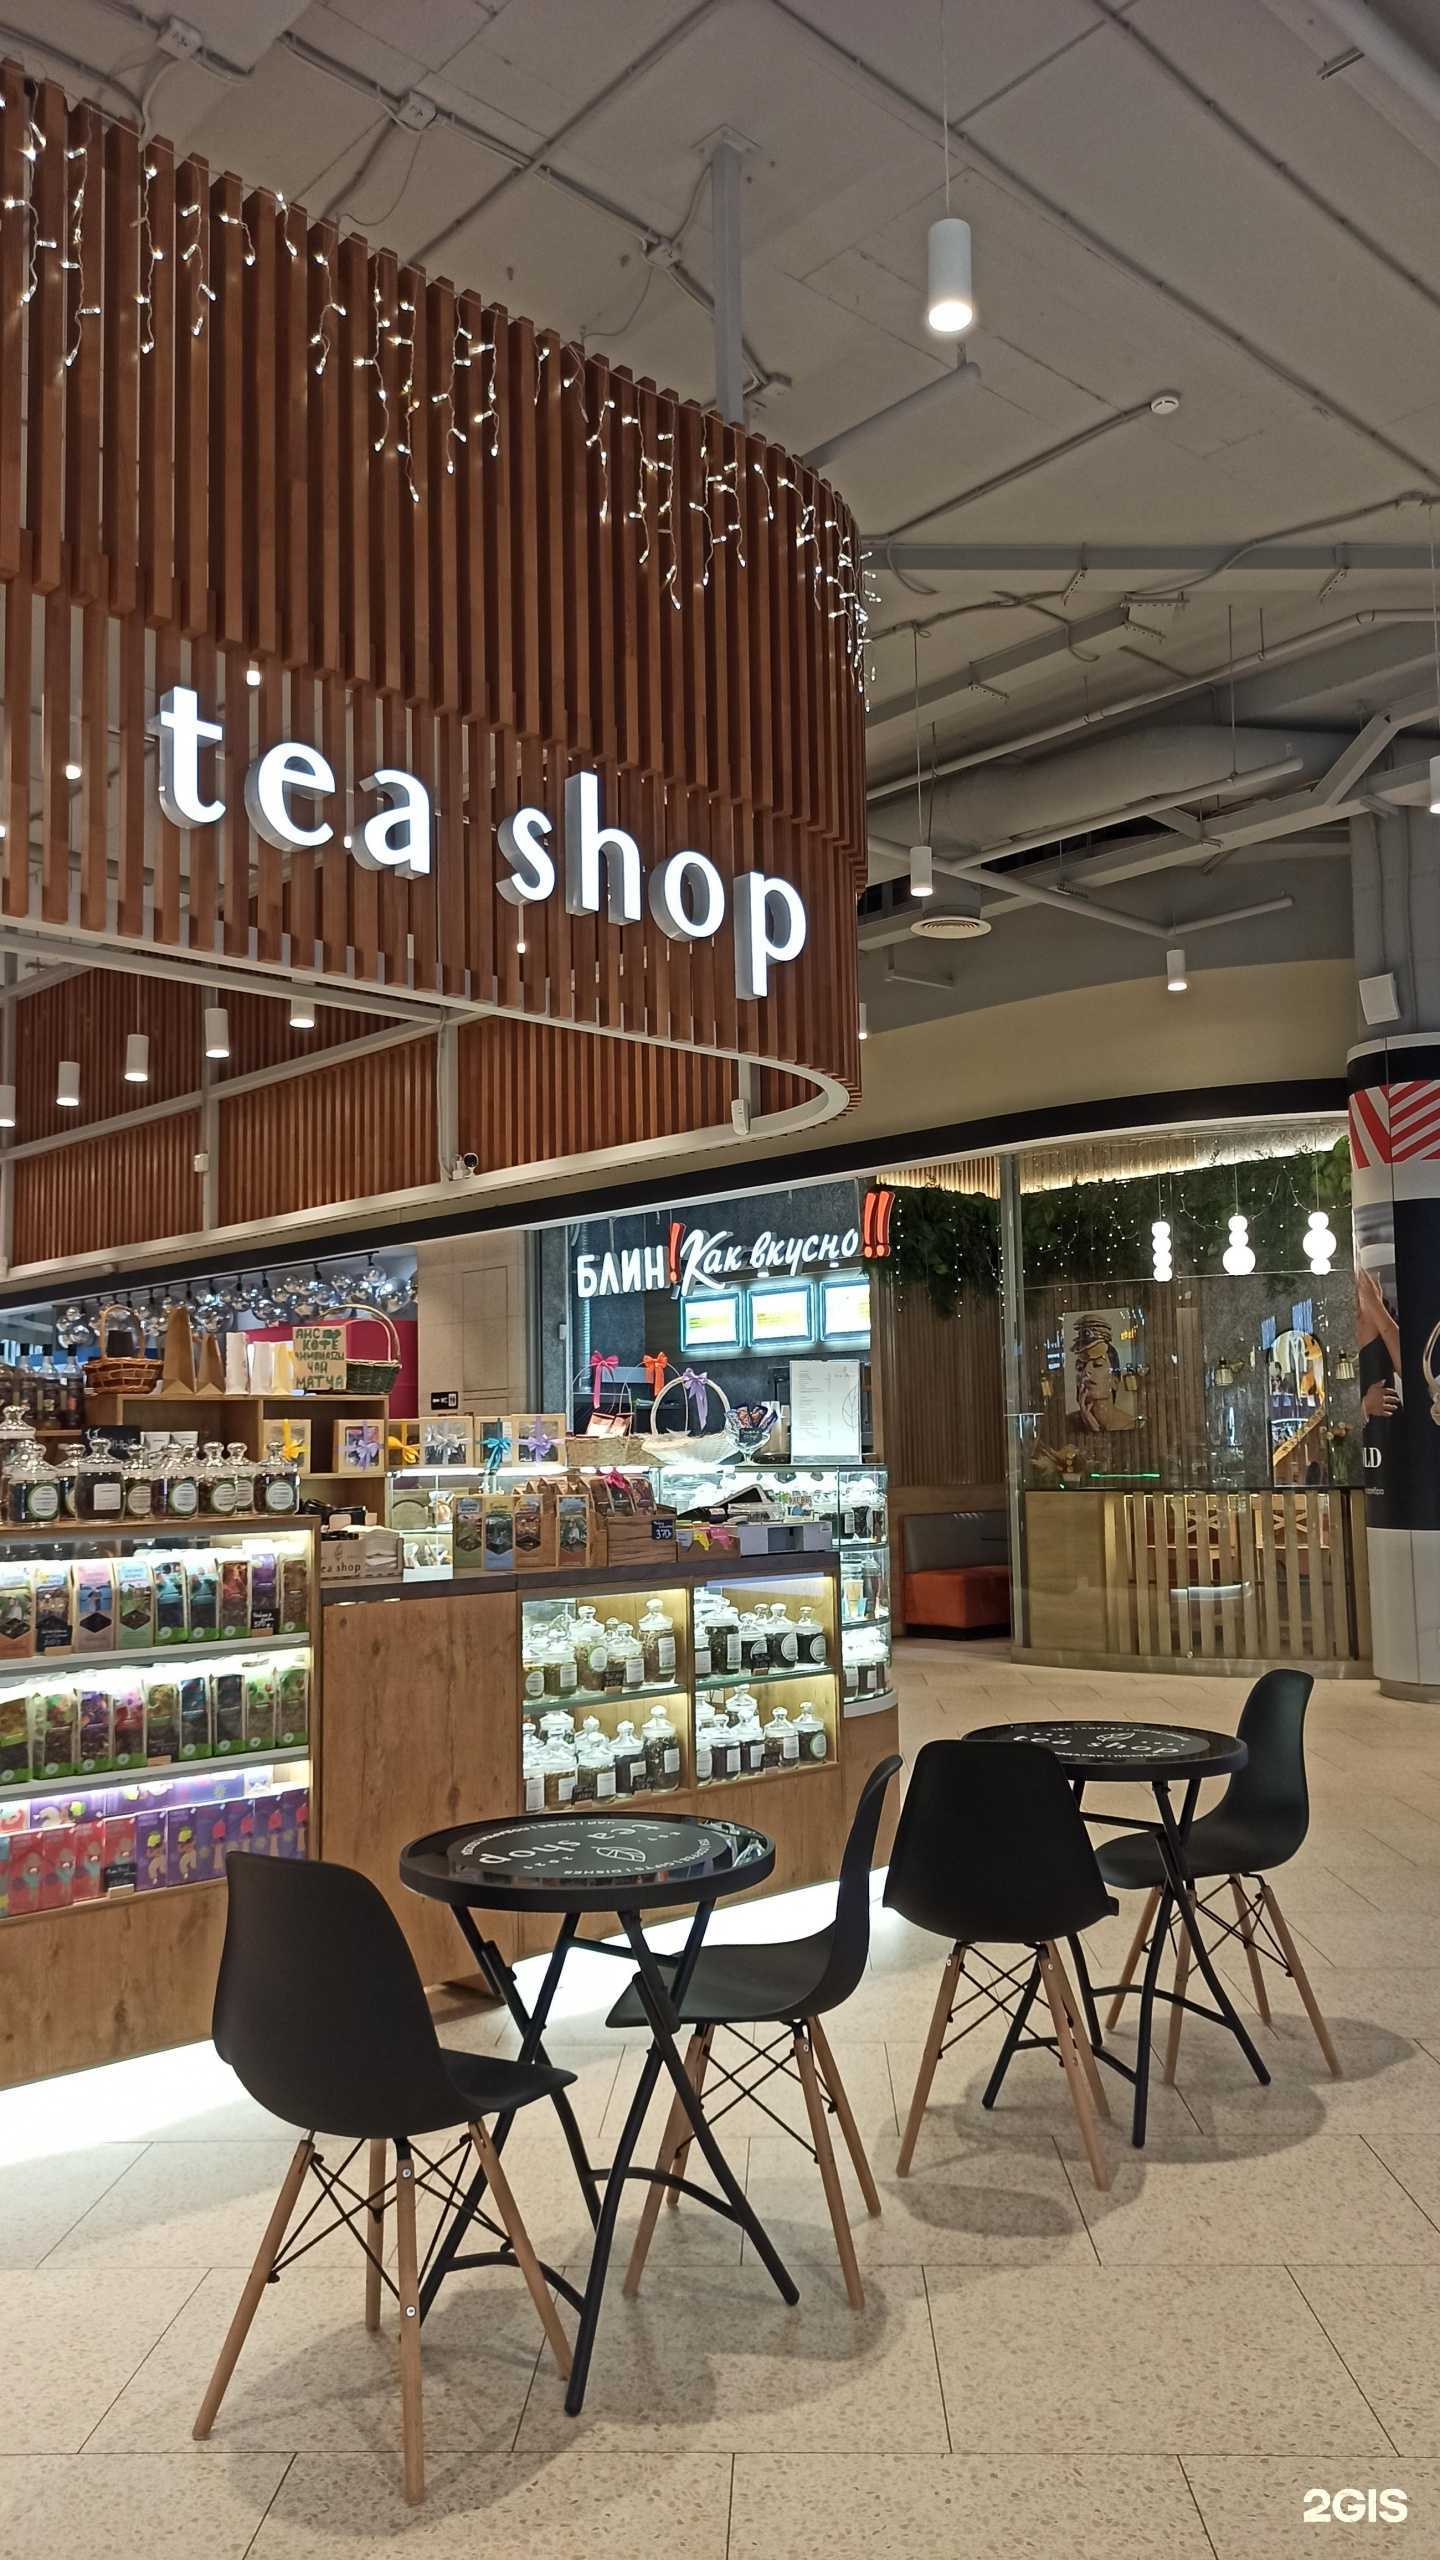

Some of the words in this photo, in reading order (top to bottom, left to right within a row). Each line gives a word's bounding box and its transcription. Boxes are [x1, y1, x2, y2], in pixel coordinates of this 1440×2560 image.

[160, 686, 430, 876] tea
[501, 771, 807, 1000] shop
[680, 1228, 742, 1297] Как
[478, 1838, 581, 1865] shop
